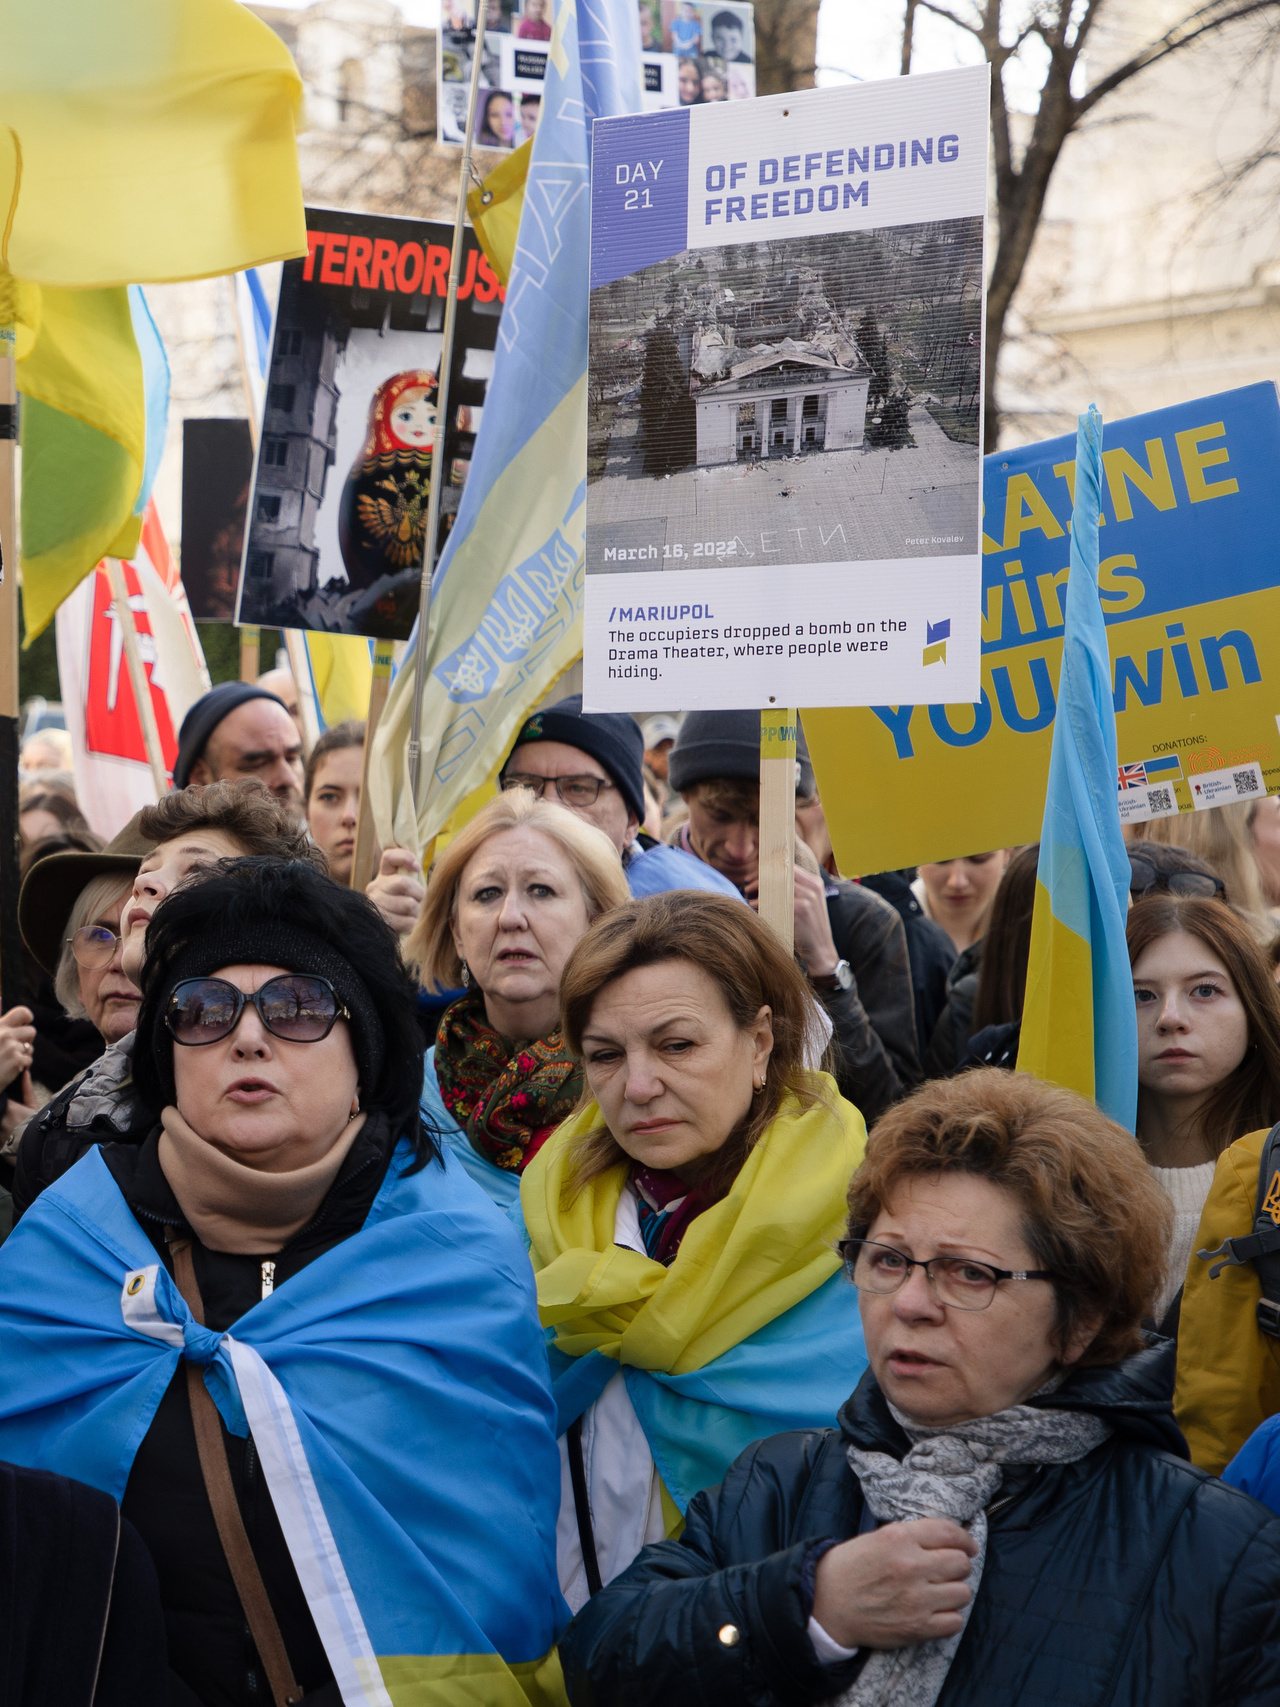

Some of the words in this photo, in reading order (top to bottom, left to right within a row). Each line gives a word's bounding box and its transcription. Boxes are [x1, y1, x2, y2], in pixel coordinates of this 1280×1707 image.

[616, 160, 663, 184] DAY
[705, 161, 747, 193] OF
[759, 134, 959, 186] DEFENDING
[624, 188, 653, 210] 21
[705, 180, 869, 225] FREEDOM
[302, 230, 507, 304] TERRORUS
[604, 545, 658, 561] March
[663, 543, 689, 560] 16,
[693, 541, 738, 557] 2022
[905, 536, 929, 546] Peter
[931, 534, 964, 544] Kovalev
[608, 604, 714, 623] /MARIUPOL
[609, 630, 635, 643] The
[639, 626, 719, 644] occupiers
[723, 624, 790, 641] dropped
[795, 625, 804, 636] a
[809, 621, 852, 635] bomb
[857, 622, 876, 633] on
[880, 619, 907, 632] the
[609, 648, 658, 661] Drama
[663, 646, 729, 661] Theater,
[734, 643, 784, 657] where
[788, 640, 842, 658] people
[846, 640, 888, 652] were
[608, 664, 662, 680] hiding.
[1112, 623, 1262, 714] win
[1152, 735, 1208, 753] DONATIONS:
